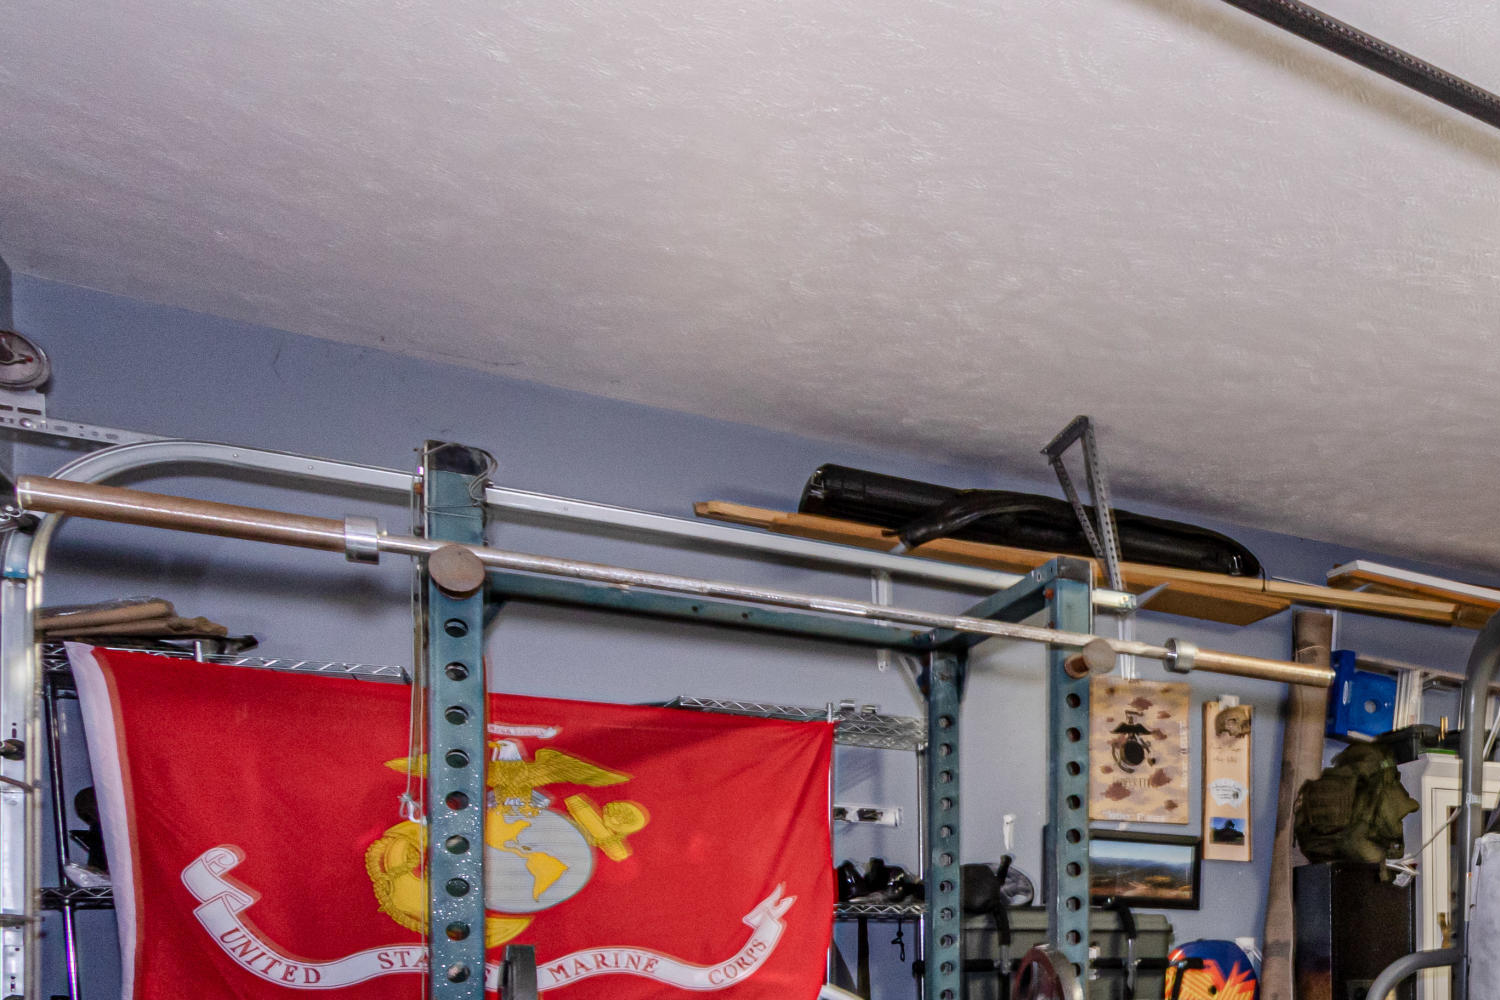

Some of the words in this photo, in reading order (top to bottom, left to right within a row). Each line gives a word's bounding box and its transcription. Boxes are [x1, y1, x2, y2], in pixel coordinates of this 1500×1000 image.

[219, 927, 321, 984] UNITED
[547, 952, 660, 983] MARINE
[708, 939, 767, 985] CORPS
